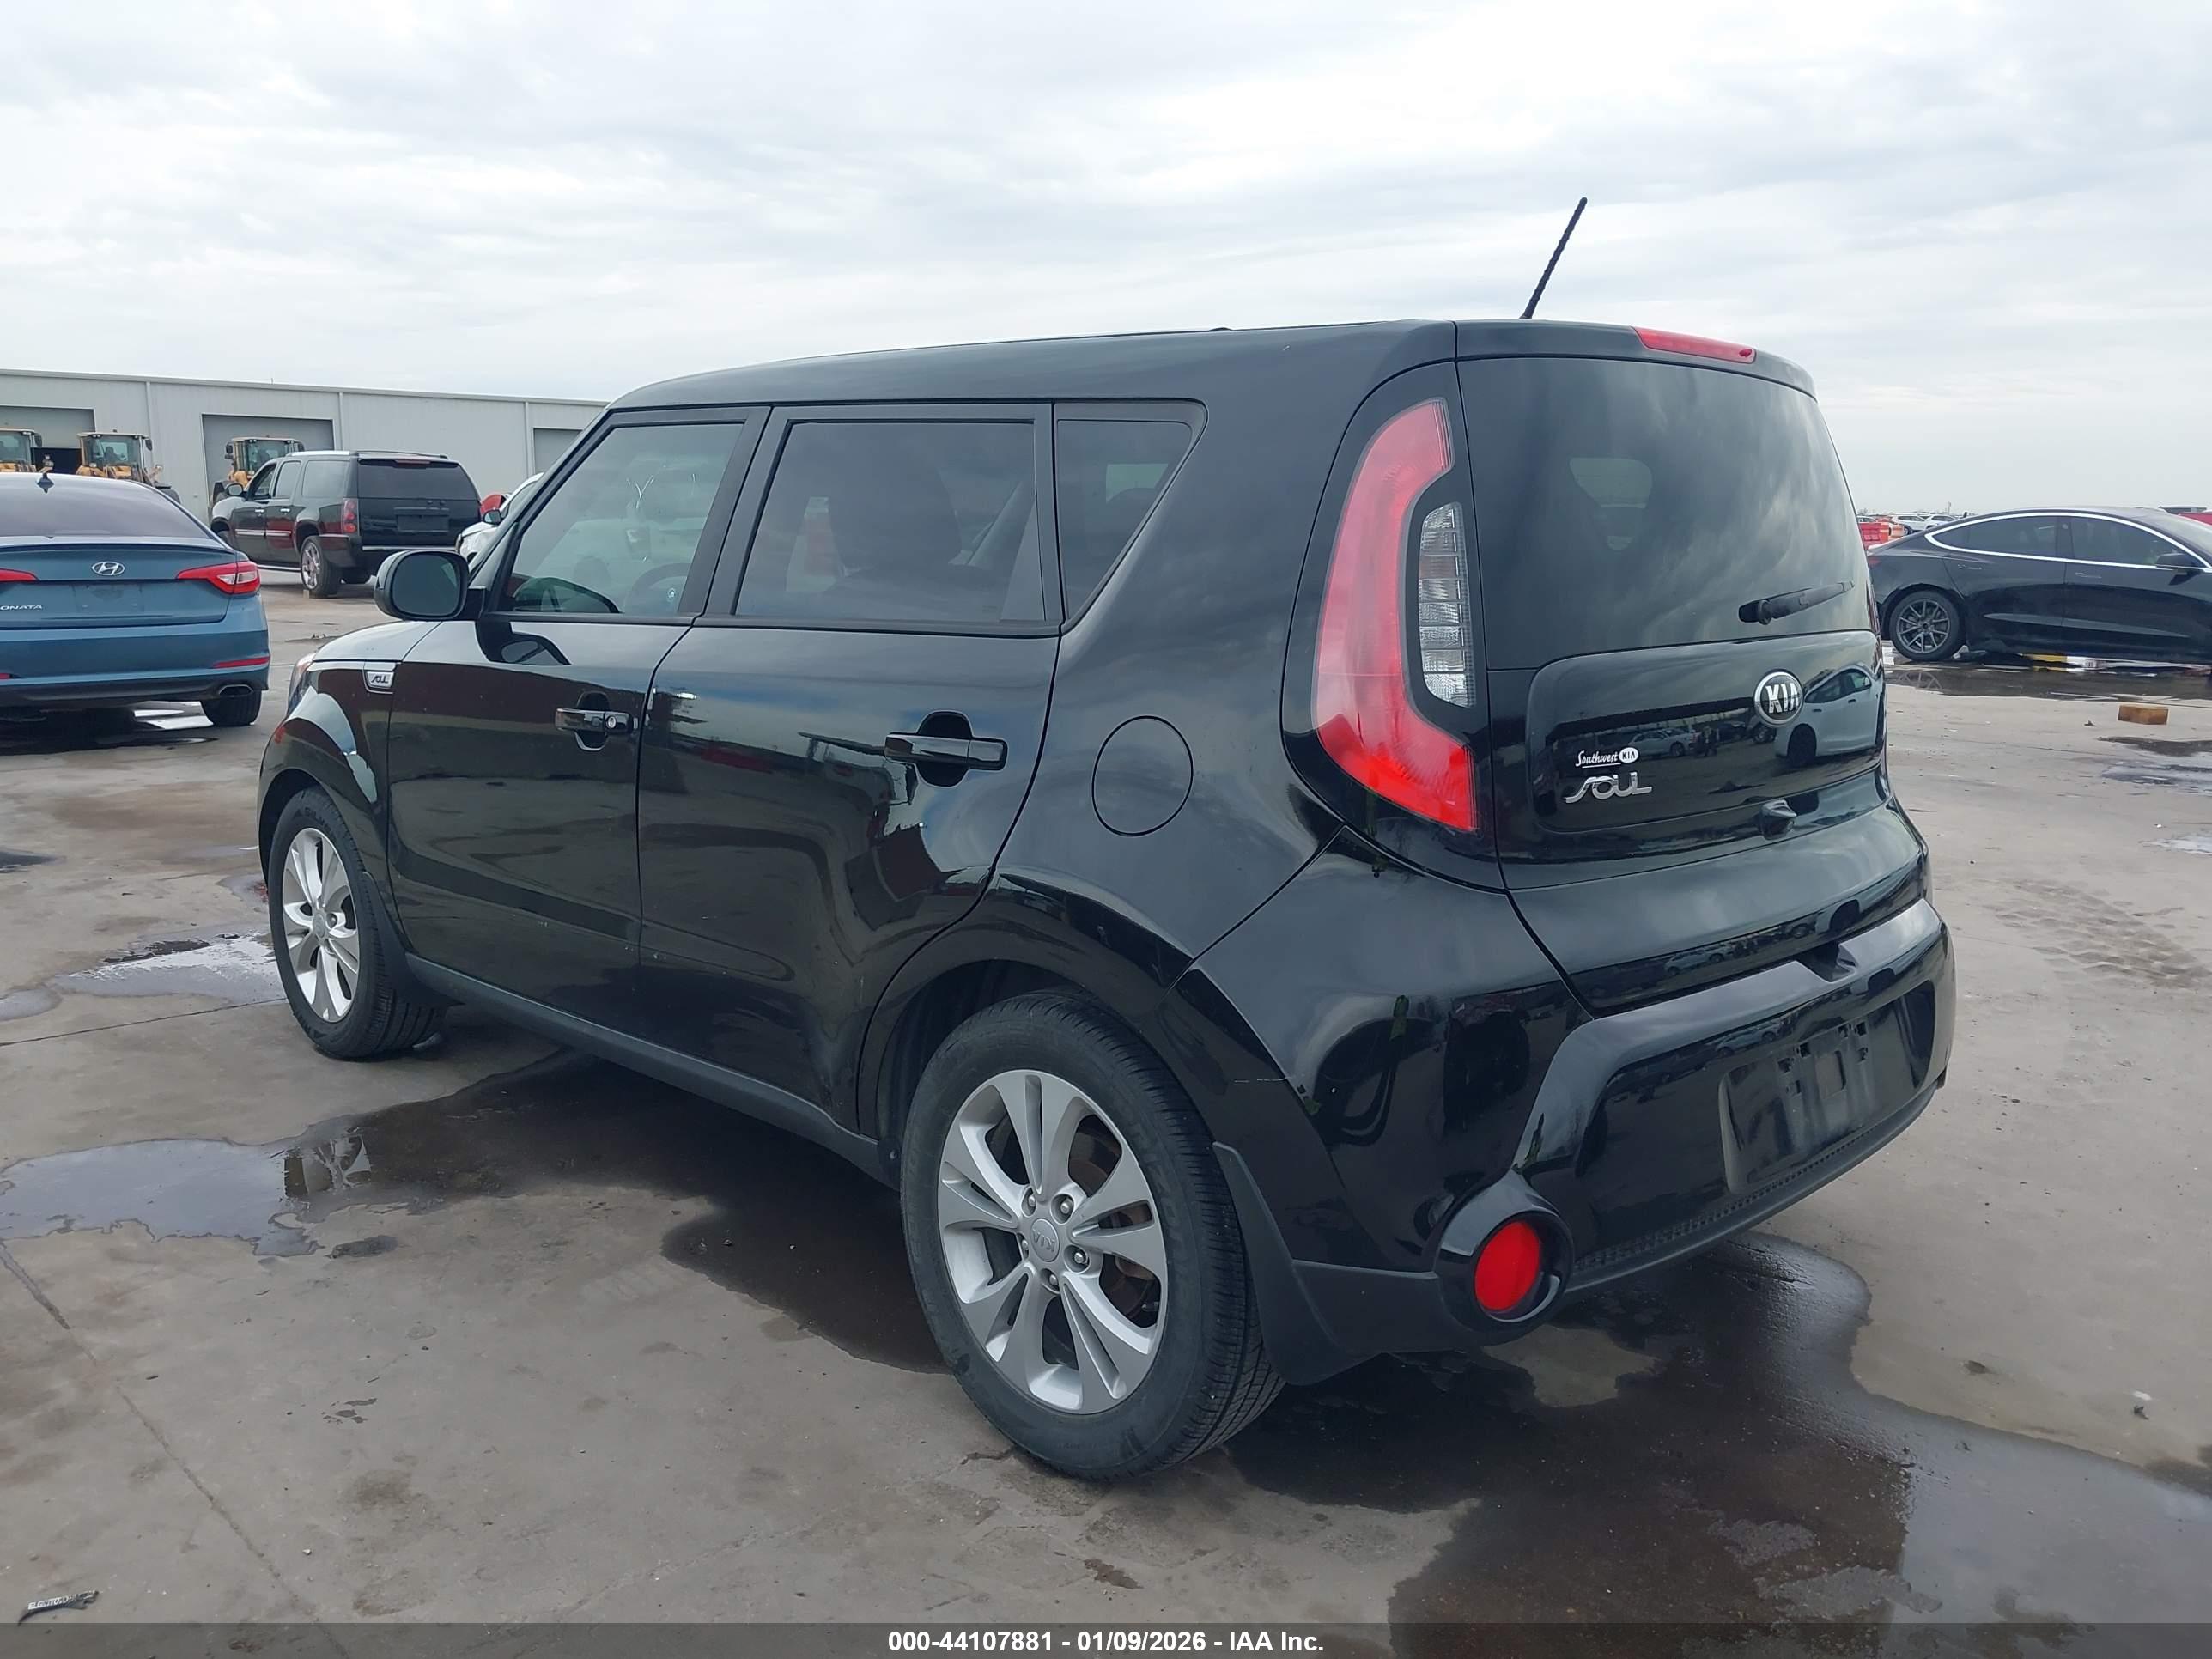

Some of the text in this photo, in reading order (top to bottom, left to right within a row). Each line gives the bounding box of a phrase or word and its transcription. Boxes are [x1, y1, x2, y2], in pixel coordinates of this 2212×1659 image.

[1765, 683, 1799, 714] KIA
[1576, 750, 1636, 767] Southwest KIA
[1565, 772, 1652, 804] SOUL
